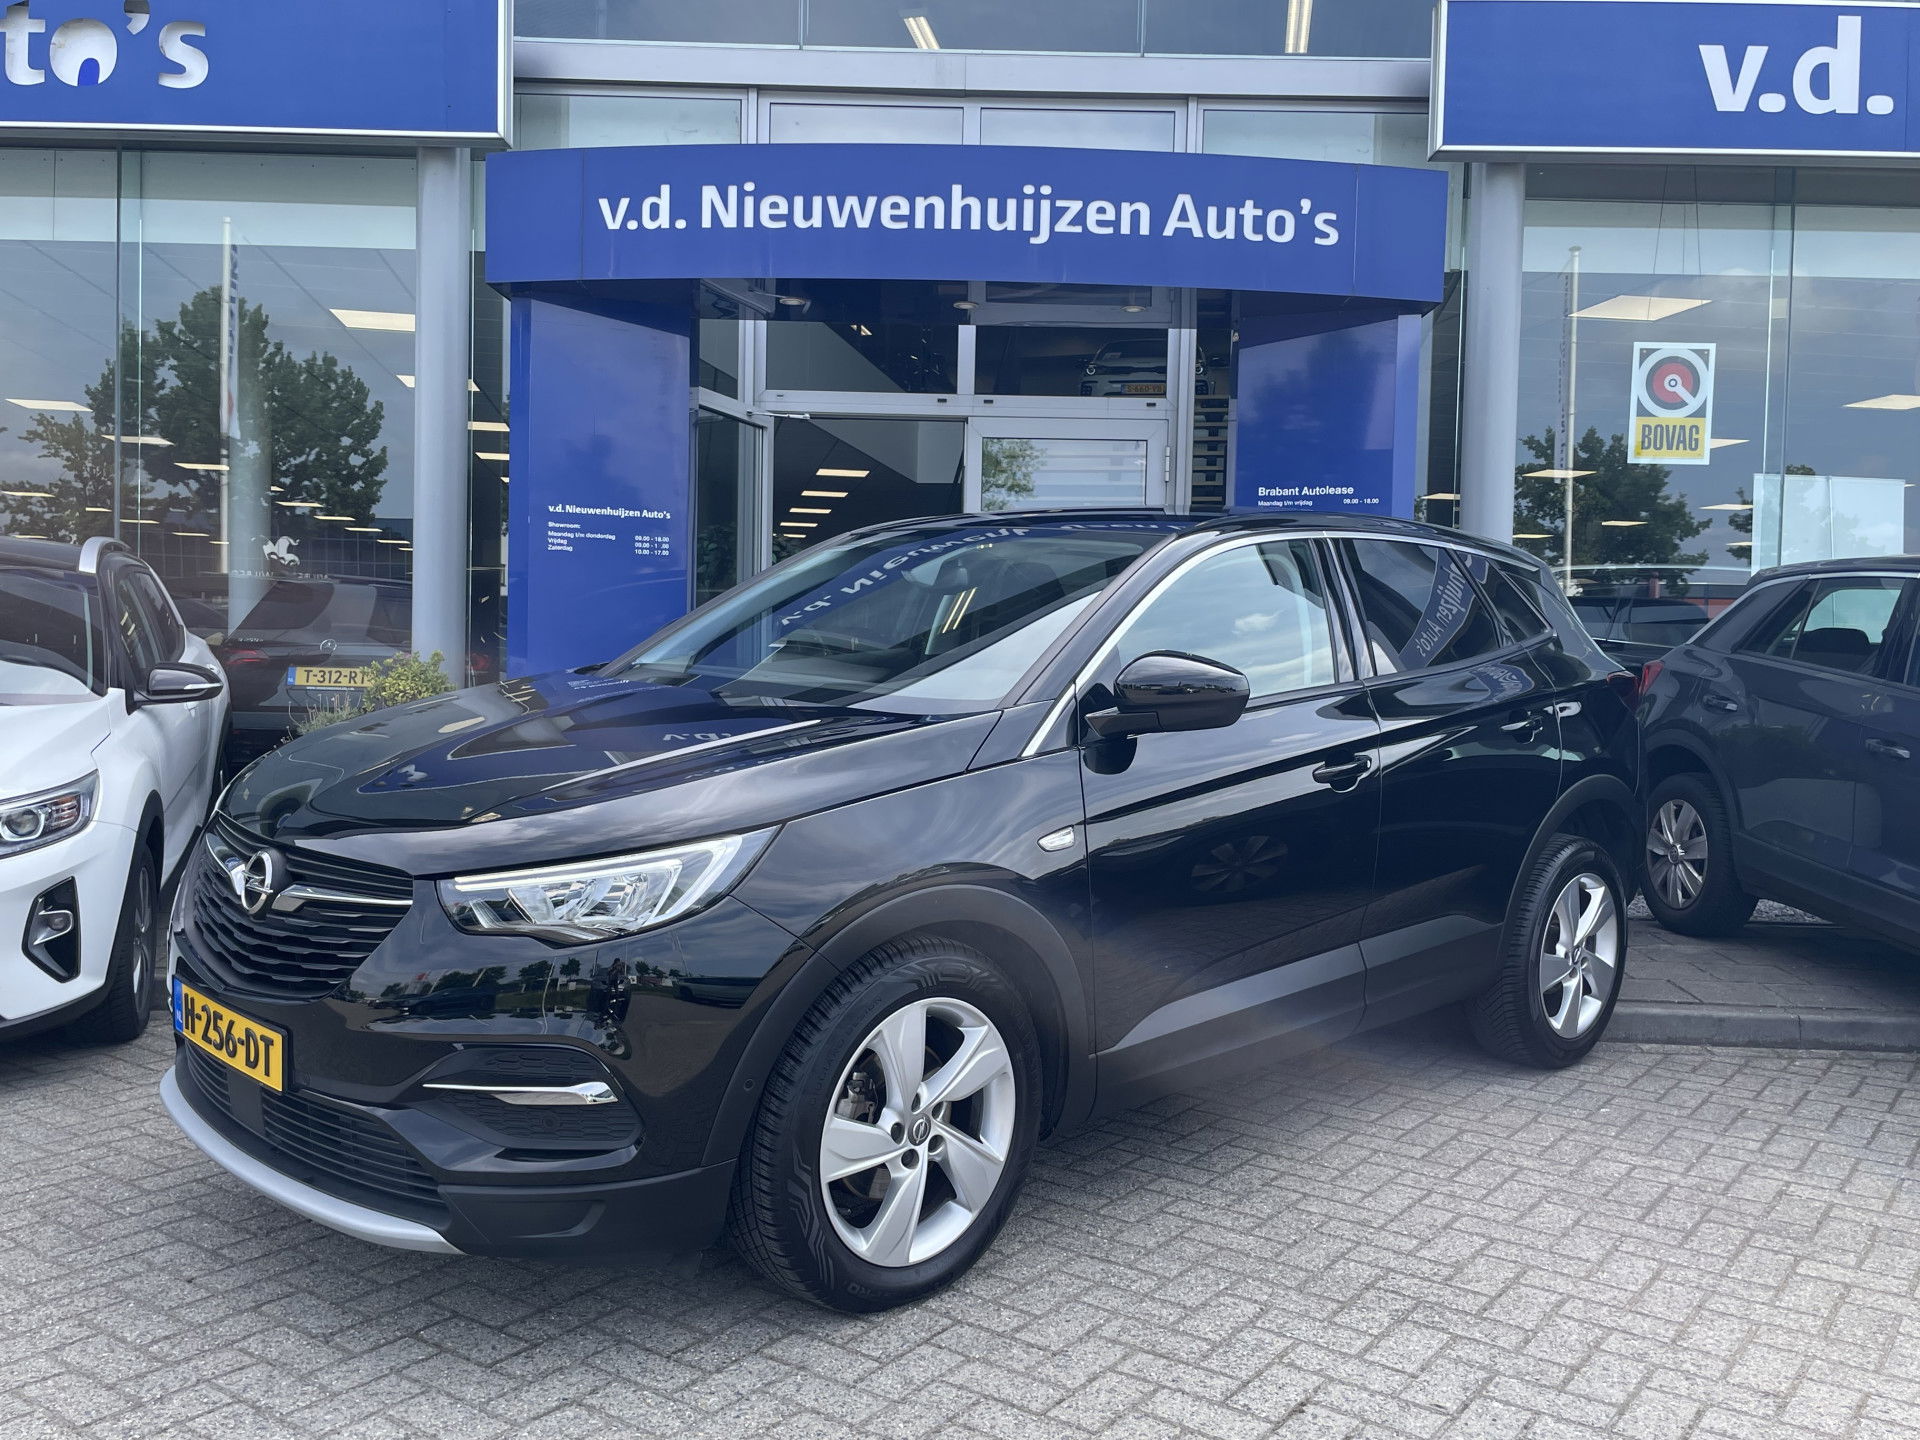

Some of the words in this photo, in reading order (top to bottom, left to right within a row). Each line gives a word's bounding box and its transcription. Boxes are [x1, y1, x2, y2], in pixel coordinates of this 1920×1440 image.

[1699, 15, 1895, 115] v.d.
[598, 184, 687, 231] v.d.
[701, 181, 1151, 245] Nieuwenhuijzen
[1162, 193, 1340, 246] Auto's
[1641, 423, 1700, 451] BOVAG
[548, 503, 565, 513] v.d.
[565, 504, 641, 518] Nieuwenhuijzen
[641, 509, 671, 519] Auto's
[1258, 486, 1299, 496] Brabant
[1301, 485, 1354, 496] Autolease
[184, 992, 275, 1078] H-256-DT
